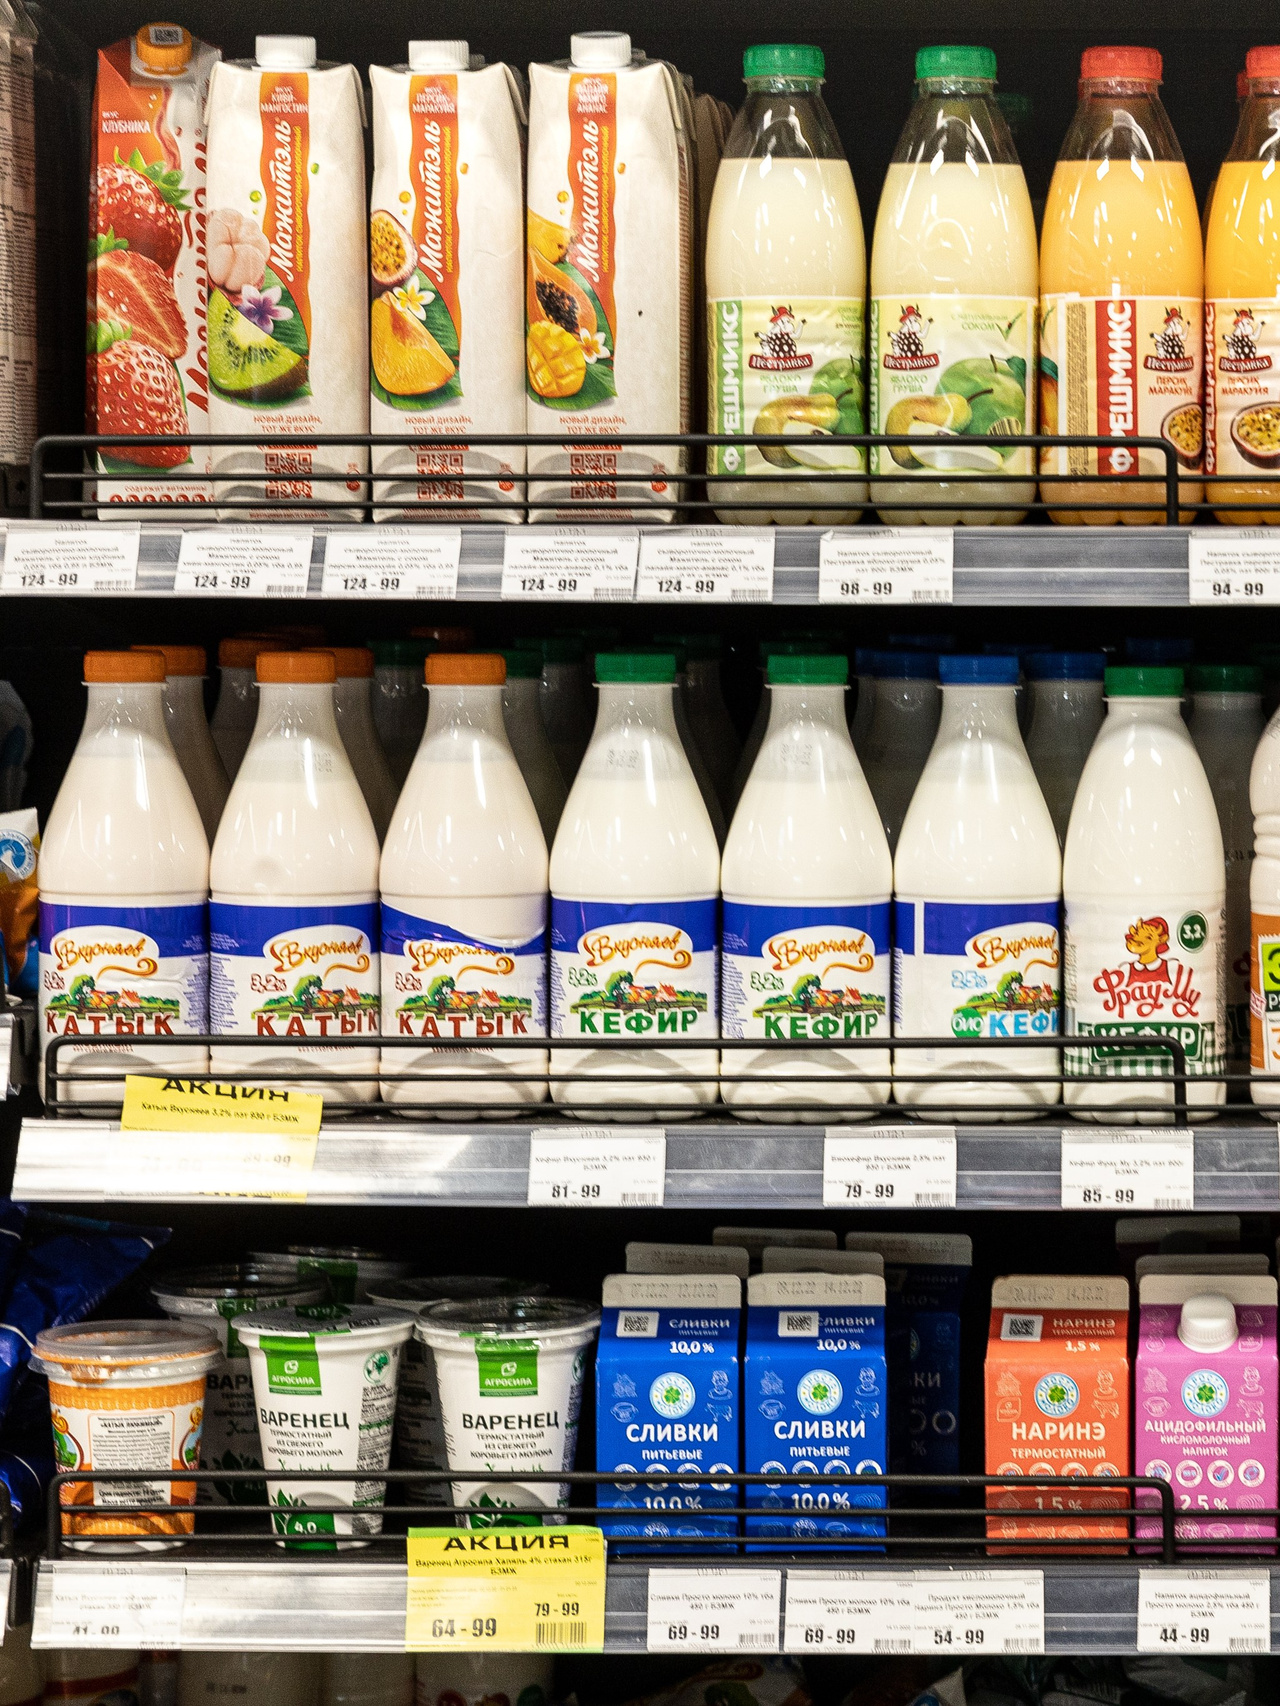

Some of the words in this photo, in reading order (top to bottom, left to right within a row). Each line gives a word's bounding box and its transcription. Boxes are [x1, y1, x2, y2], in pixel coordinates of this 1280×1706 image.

[102, 119, 150, 133] КЛУБНИКА
[270, 120, 294, 283] Мажитэль
[418, 120, 443, 283] Мажитэль
[576, 120, 601, 283] Мажитэль
[752, 353, 810, 370] Пестравка
[884, 353, 936, 370] Пестравка
[1220, 356, 1269, 372] Пестравка
[760, 375, 801, 384] ЯБЛОКО
[1156, 375, 1187, 385] ПЕРСИК
[763, 384, 798, 394] ГРУША
[892, 384, 923, 394] ГРУША
[1108, 301, 1135, 473] ФЕШМИКС
[1148, 385, 1193, 396] МАРАКУЙЯ
[1221, 385, 1269, 396] МАРАКУЙЯ
[254, 416, 284, 425] НОВЫЙ
[405, 416, 436, 425] НОВЫЙ
[559, 416, 588, 425] НОВЫЙ
[262, 425, 277, 434] ТОТ
[279, 425, 292, 434] ЖЕ
[1093, 968, 1164, 1019] Фрау
[1163, 963, 1202, 1018] Му
[46, 1011, 174, 1035] КАТЫК
[256, 1013, 380, 1037] КАТЫК
[399, 1012, 529, 1038] КАТЫК
[579, 1010, 698, 1035] КЕФИР
[764, 1012, 879, 1038] КЕФИР
[161, 1078, 290, 1103] АКЦИЯ
[669, 1318, 731, 1330] СЛИВКИ
[818, 1316, 876, 1328] СЛИВКИ
[1052, 1318, 1116, 1329] НАРИНЭ
[272, 1374, 316, 1386] АГРОСИЛА
[484, 1376, 533, 1387] АГРОСИЛА
[259, 1407, 350, 1431] ВАРЕНЕЦ
[461, 1410, 559, 1431] ВАРЕНЕЦ
[1144, 1418, 1267, 1434] АЦИДОФИЛЬНЫЙ
[625, 1423, 719, 1443] СЛИВКИ
[773, 1419, 866, 1440] СЛИВКИ
[1011, 1421, 1106, 1441] НАРИНЭ
[1160, 1433, 1251, 1446] КИСЛОМОЛОЧНЫЙ
[641, 1448, 703, 1461] ПИТЬЕВЫЕ
[789, 1445, 851, 1458] ПИТЬЕВЫЕ
[1010, 1446, 1107, 1460] ТЕРМОСТАТНЫЙ
[1182, 1445, 1229, 1457] НАПИТОК
[443, 1535, 570, 1552] АКЦИЯ
[415, 1558, 452, 1567] Варенец
[454, 1558, 494, 1567] Агросила
